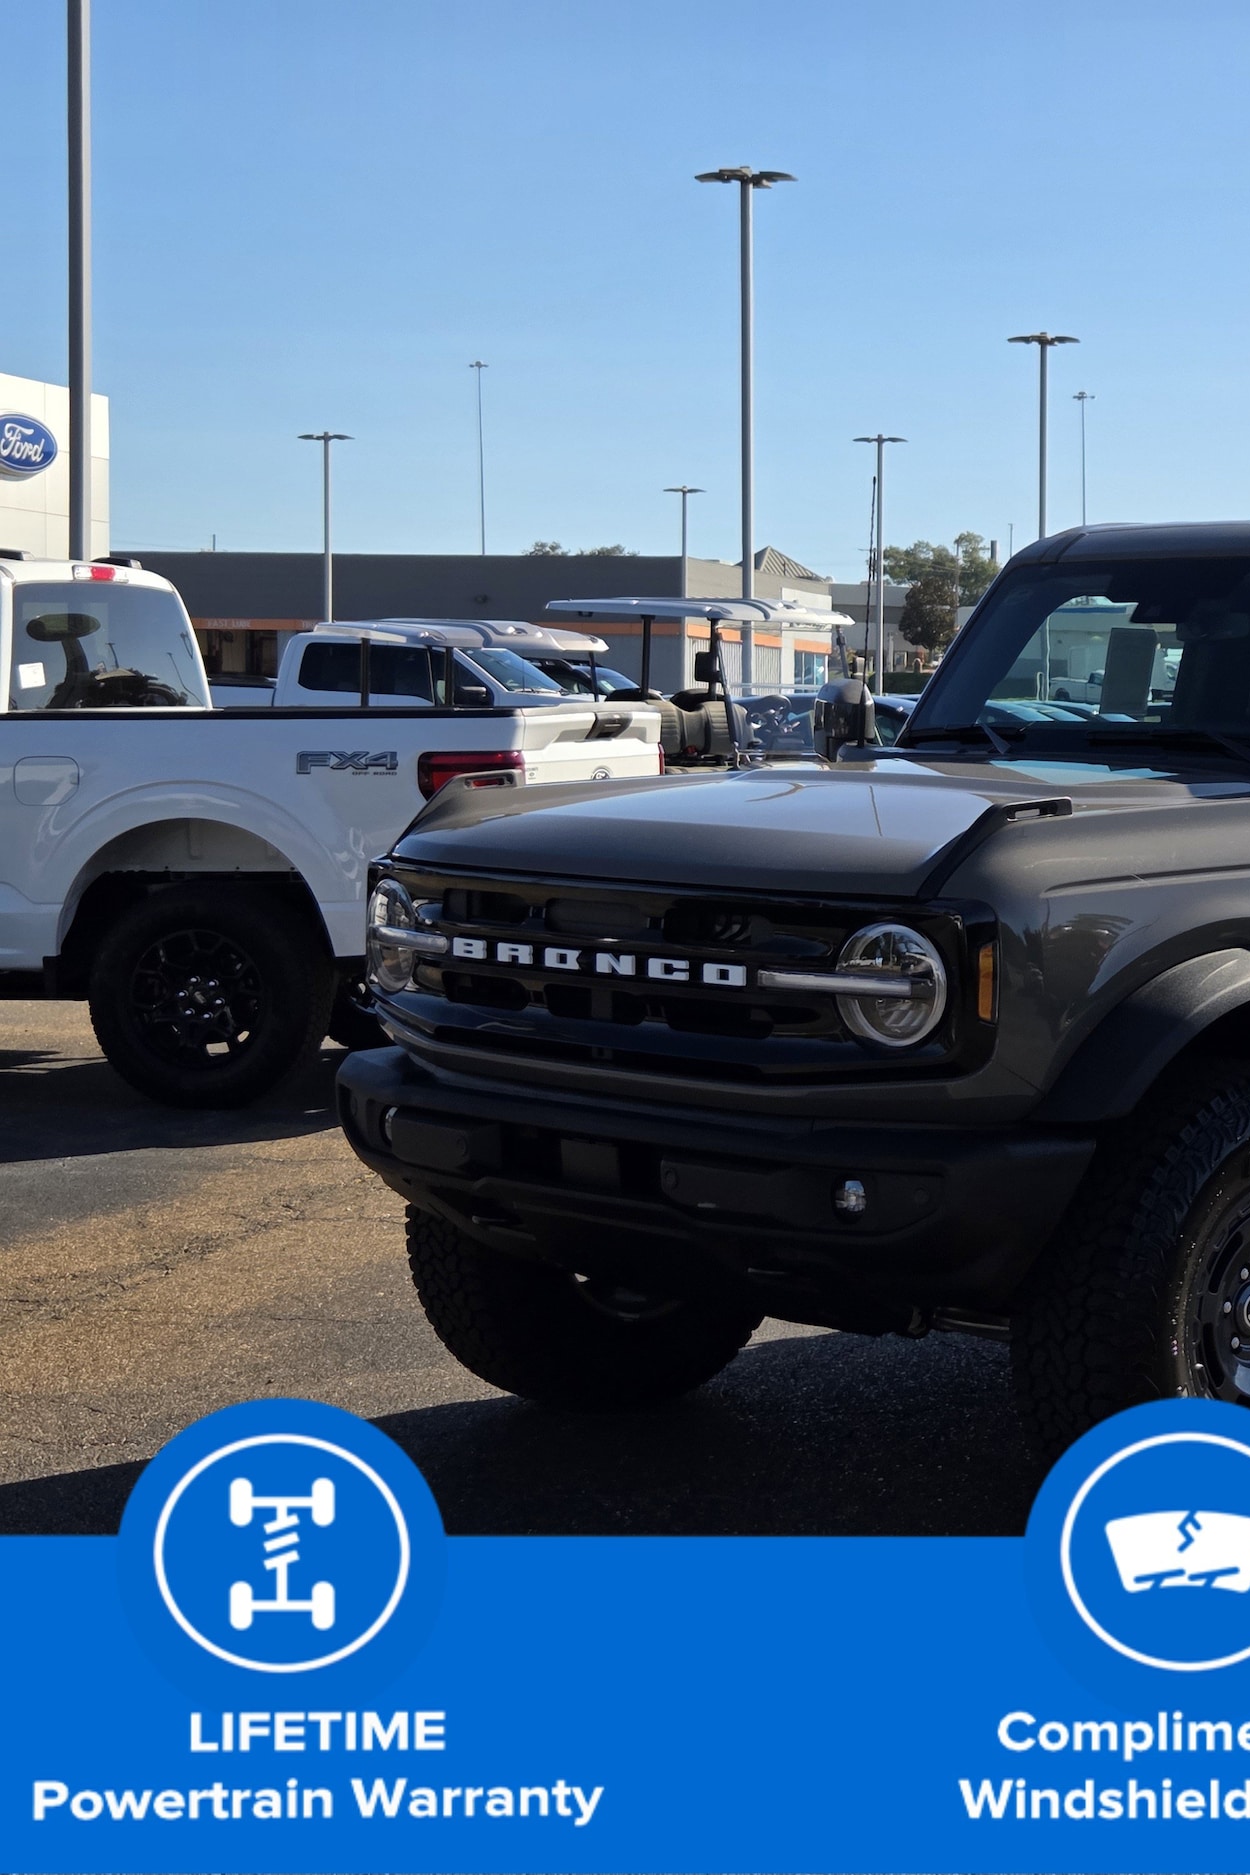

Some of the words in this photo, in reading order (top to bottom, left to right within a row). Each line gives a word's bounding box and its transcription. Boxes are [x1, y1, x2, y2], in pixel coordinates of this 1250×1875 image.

[0, 423, 46, 462] Ford
[296, 750, 398, 774] FX4
[452, 936, 747, 987] BRONCO
